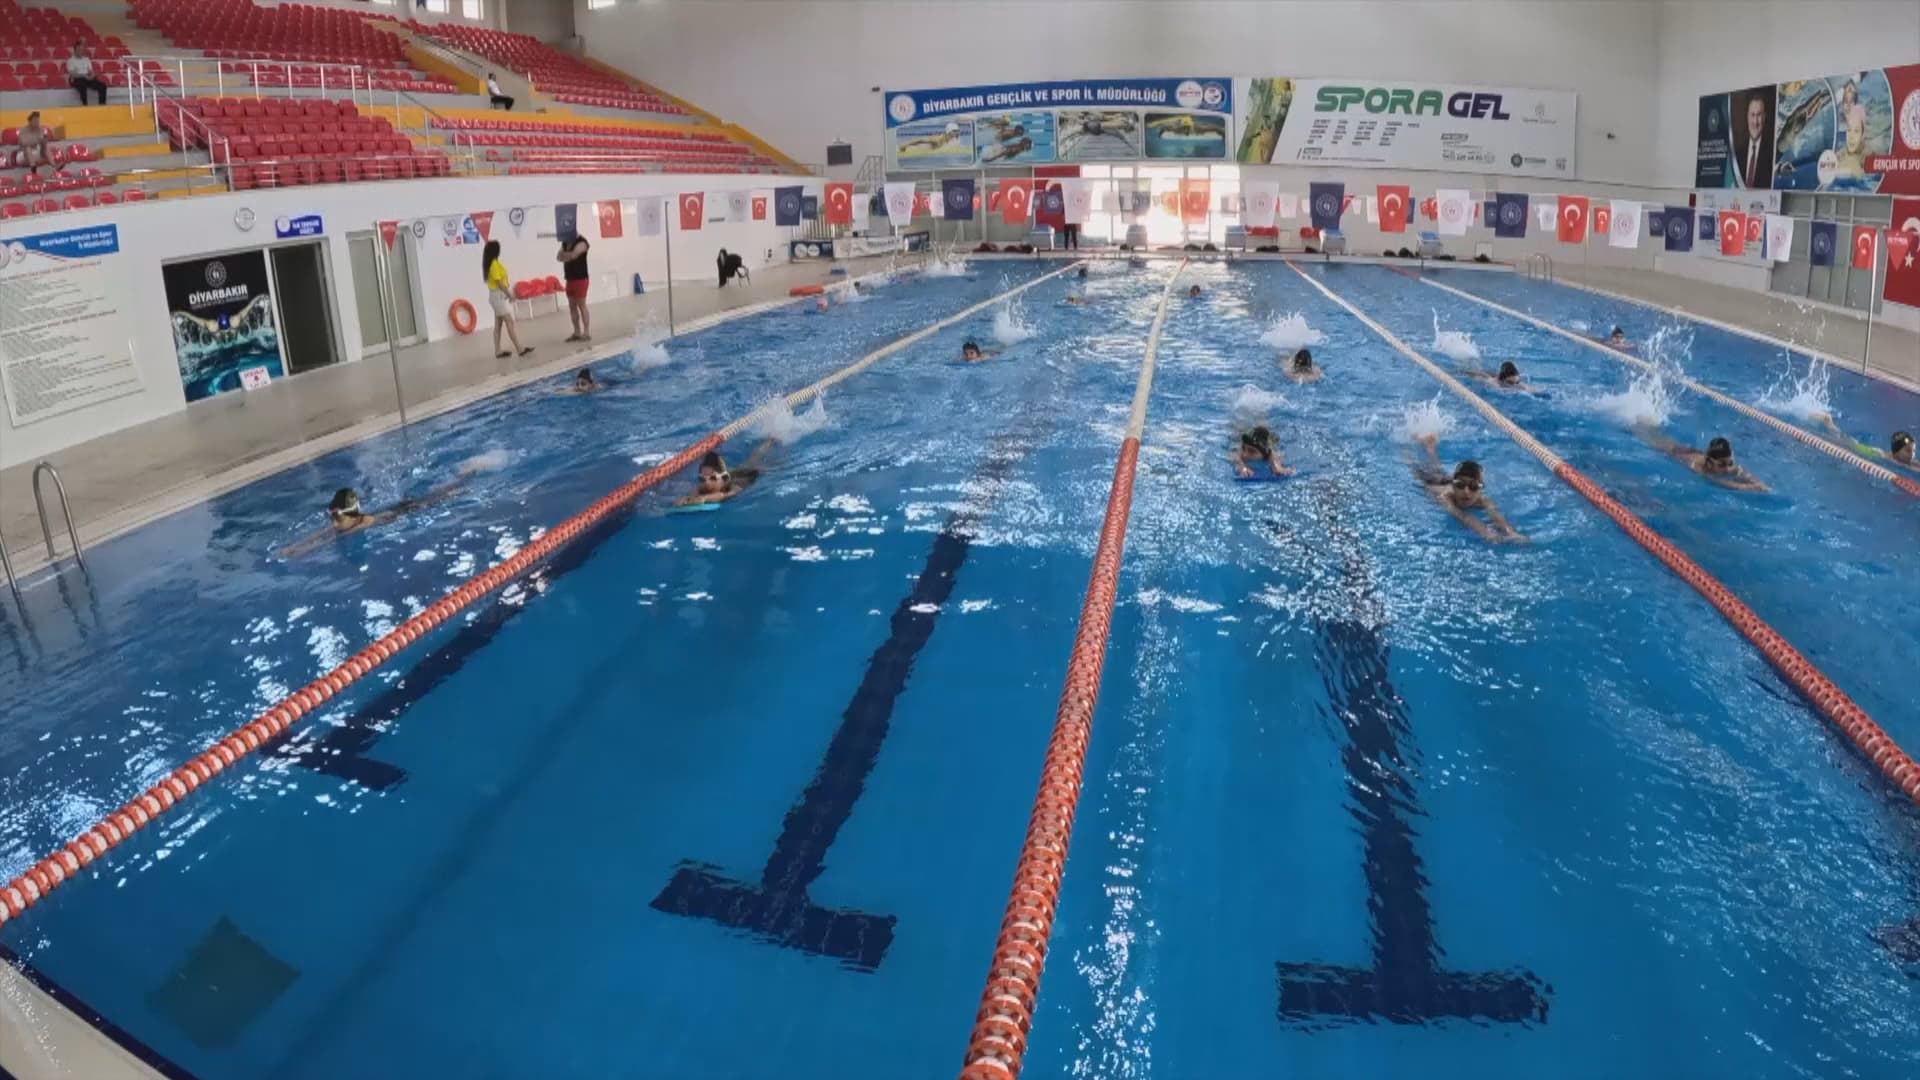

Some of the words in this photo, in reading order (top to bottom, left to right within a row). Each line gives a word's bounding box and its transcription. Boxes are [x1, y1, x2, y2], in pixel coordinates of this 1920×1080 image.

[923, 95, 984, 113] DİYARBAKIR
[987, 88, 1032, 106] GENÇLİK
[1035, 89, 1048, 100] VE
[1052, 88, 1081, 101] SPOR
[1084, 86, 1094, 100] İL
[1097, 87, 1166, 102] MÜDÜRLÜĞÜ
[1314, 86, 1443, 116] SPORA
[1447, 91, 1510, 120] GEL
[1899, 159, 1907, 171] VE
[189, 284, 248, 305] DİYARBAKIR
